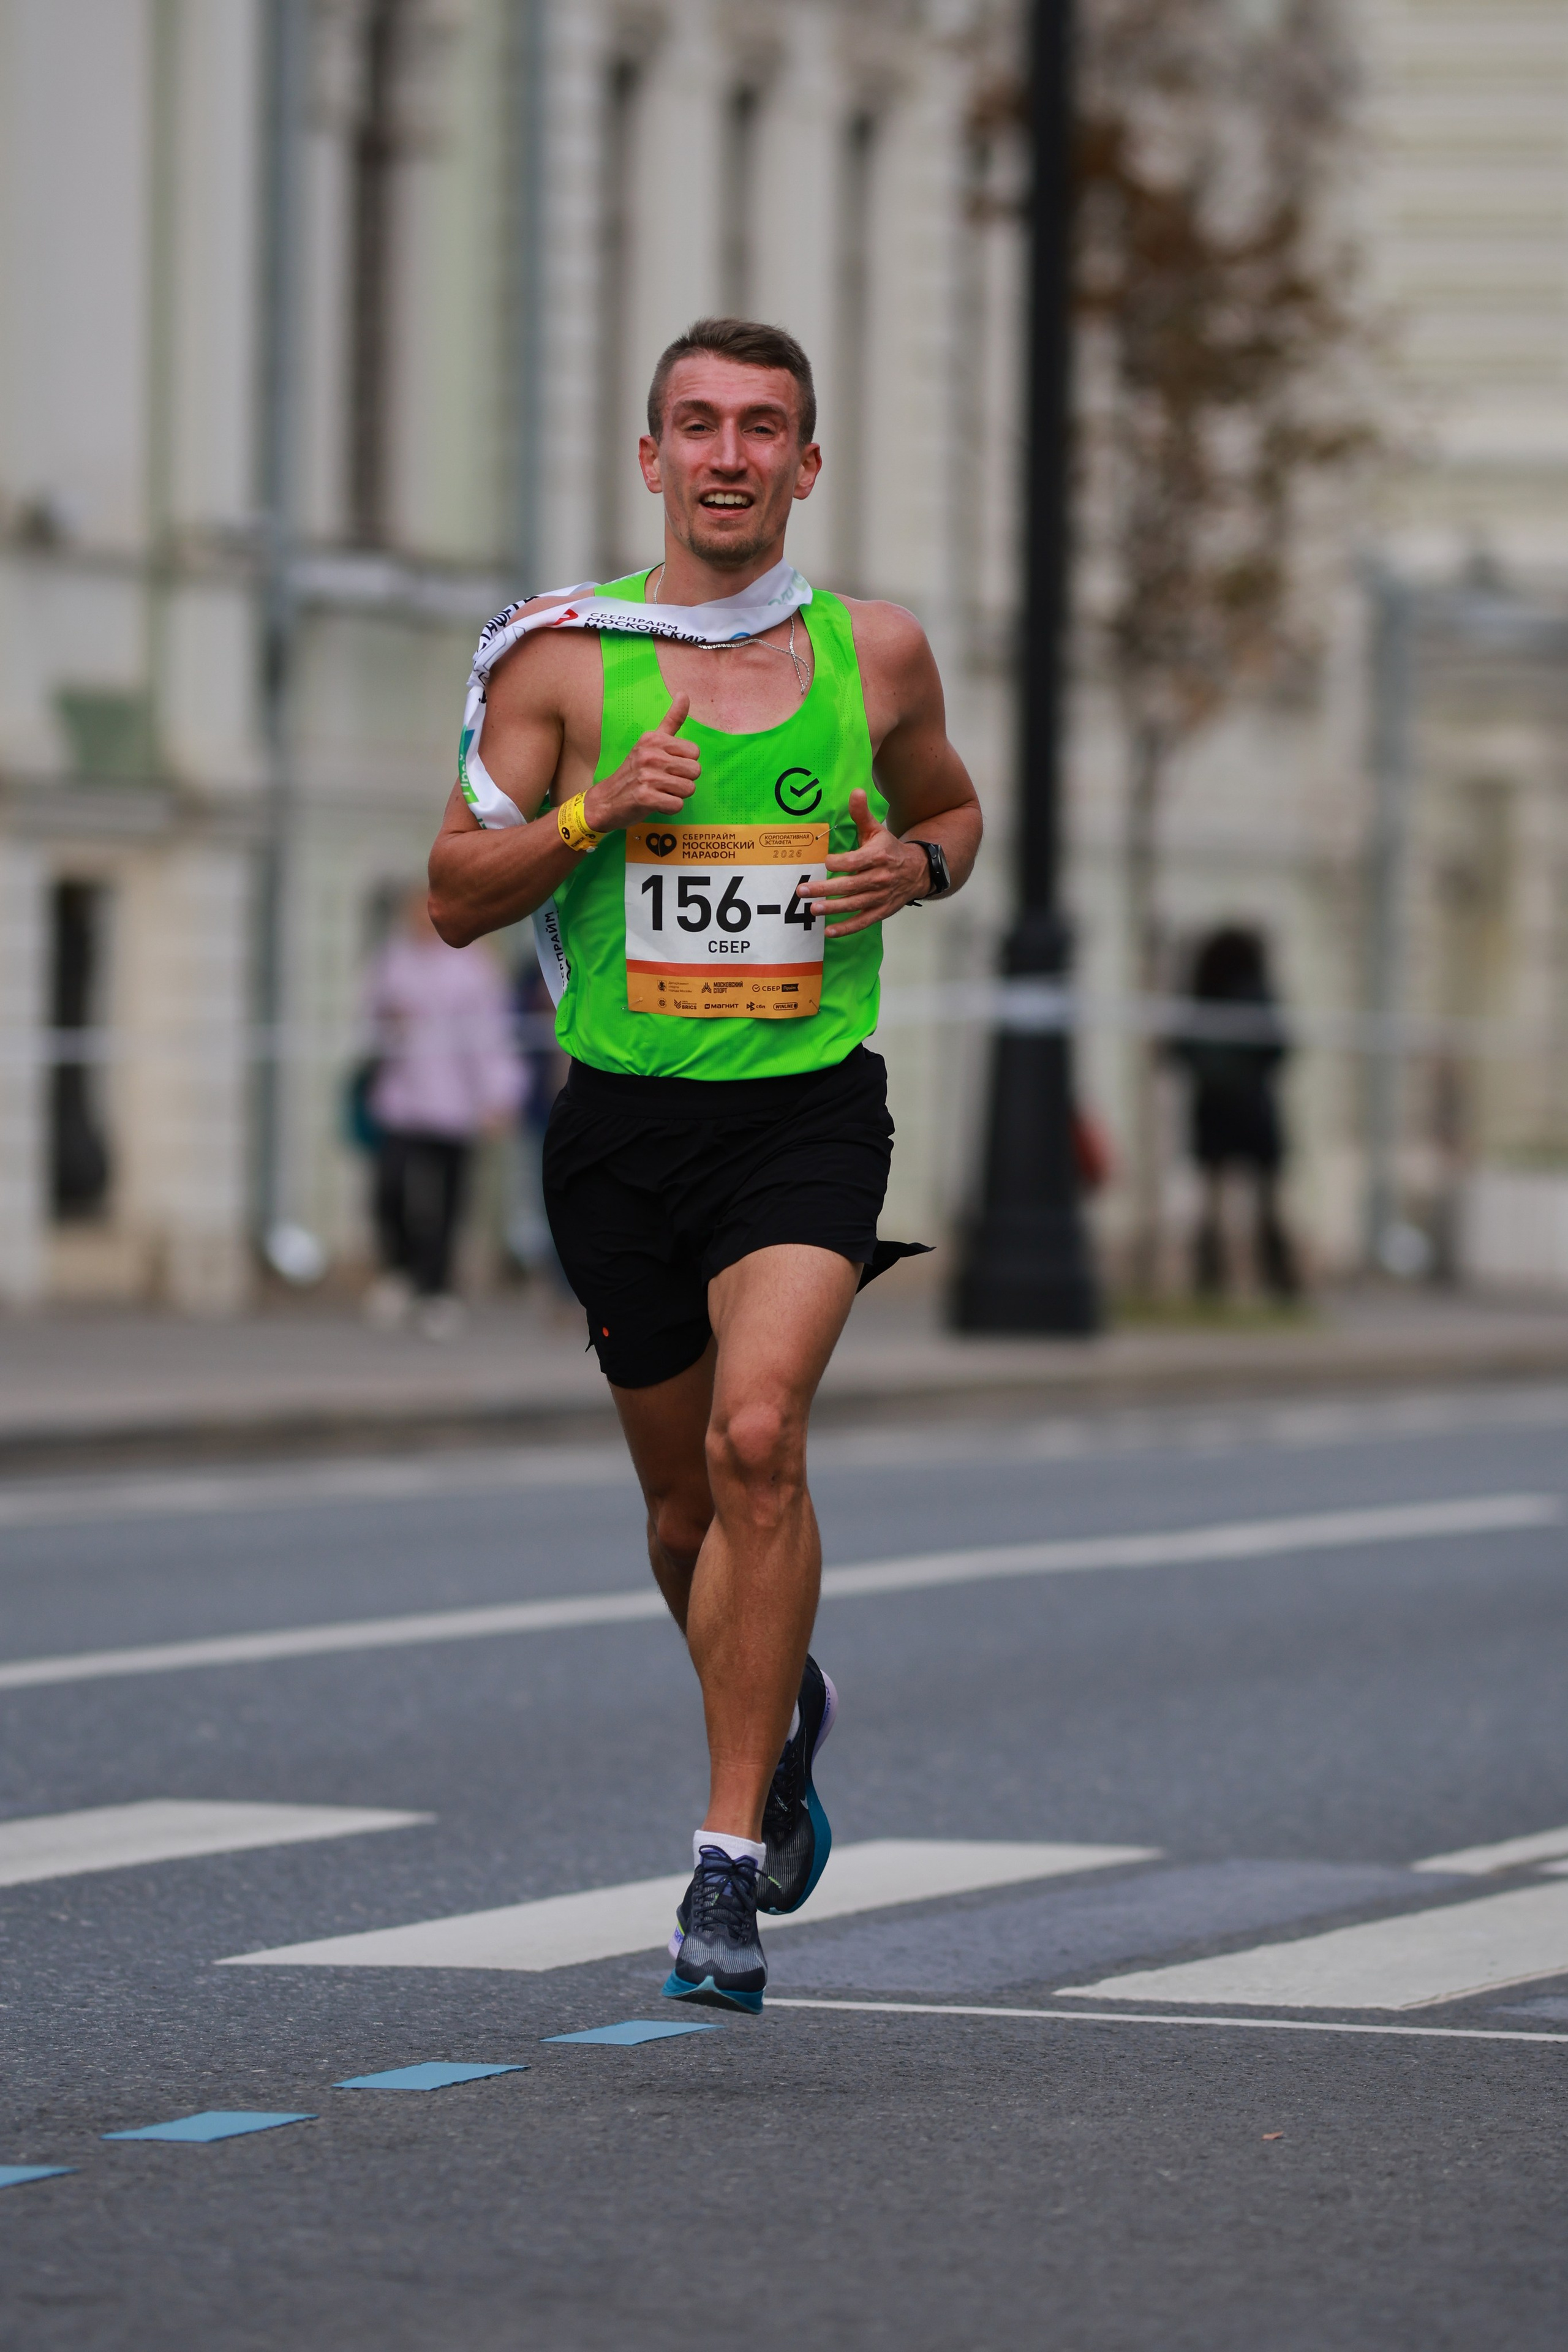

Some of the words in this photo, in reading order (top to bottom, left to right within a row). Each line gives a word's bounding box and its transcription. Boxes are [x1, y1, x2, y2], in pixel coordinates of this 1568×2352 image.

[590, 612, 679, 631] СБЕРПРАЙМ
[586, 617, 707, 643] МОСКОВСКИЙ
[682, 840, 755, 850] МОСКОВСКИЙ
[772, 849, 803, 858] 2026
[641, 875, 816, 933] 156-4
[708, 941, 750, 954] СБЕР
